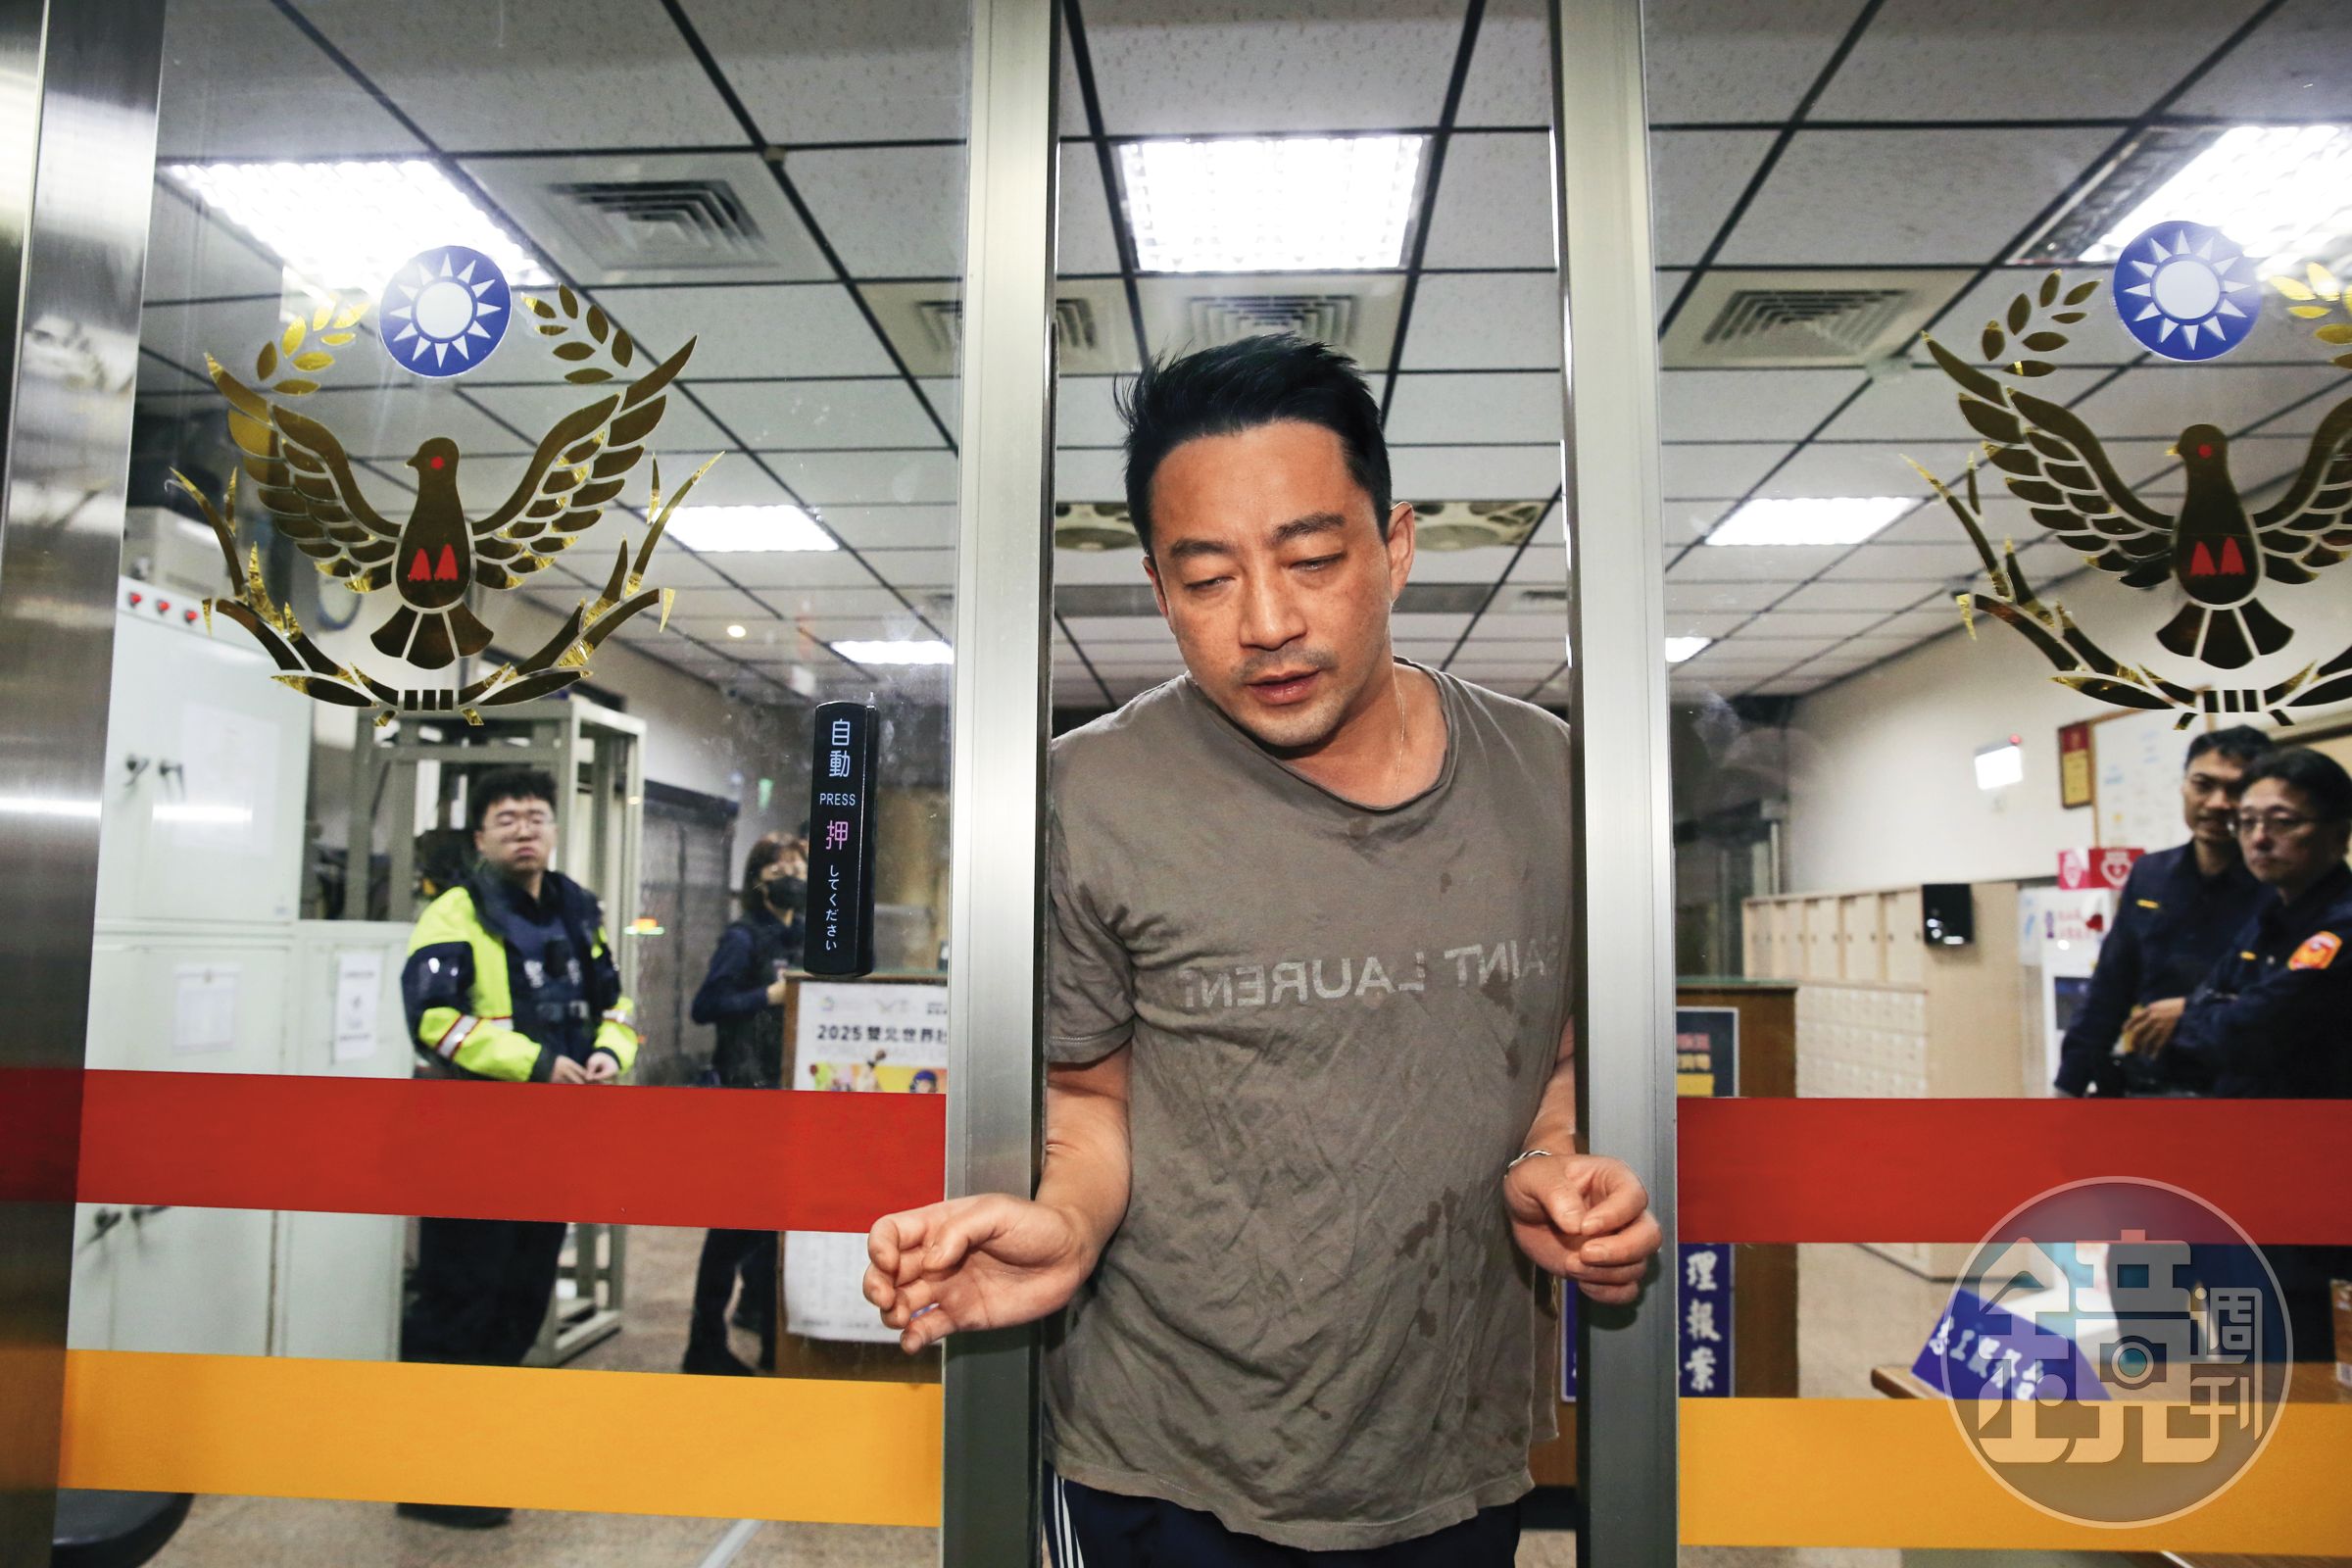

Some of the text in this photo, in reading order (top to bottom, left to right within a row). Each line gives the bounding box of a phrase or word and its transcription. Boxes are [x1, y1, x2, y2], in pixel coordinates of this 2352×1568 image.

[829, 718, 851, 777] 自動
[819, 792, 856, 807] PRESS
[1685, 1243, 1722, 1392] 理報案
